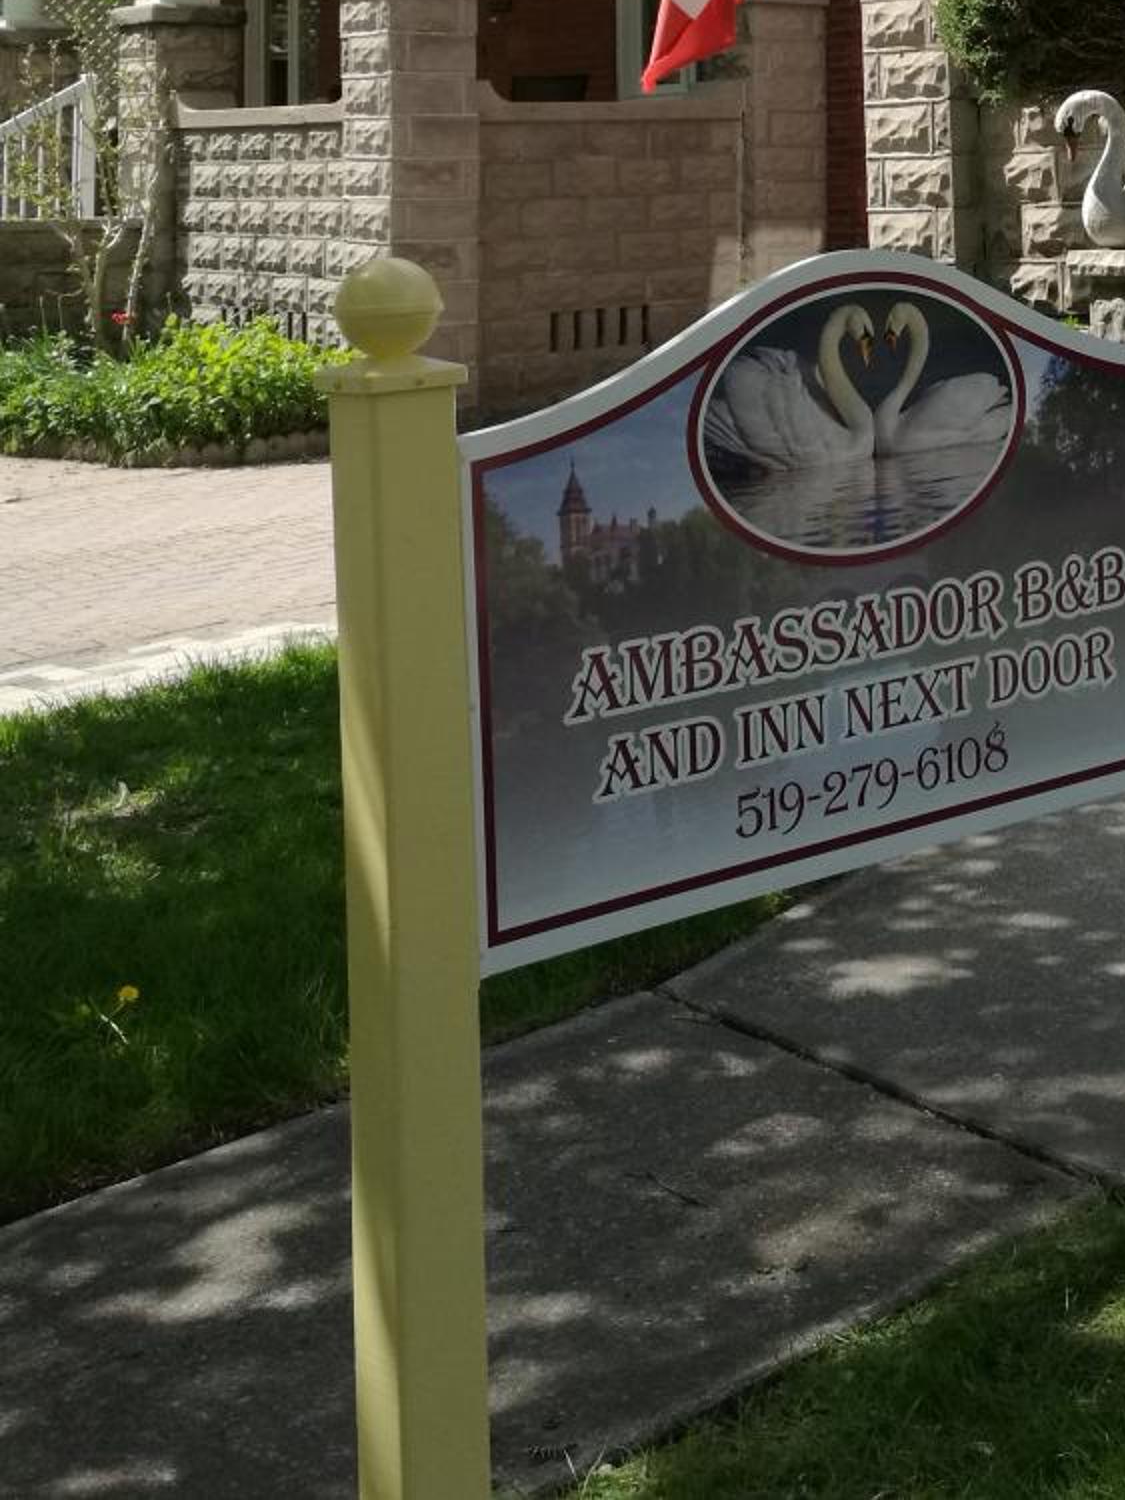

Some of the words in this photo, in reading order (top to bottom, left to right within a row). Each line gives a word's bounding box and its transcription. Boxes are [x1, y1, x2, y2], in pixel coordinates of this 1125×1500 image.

[569, 573, 1001, 719] AMBASSADOR
[598, 720, 721, 799] AND
[739, 695, 826, 765] INN
[844, 664, 975, 738] NEXT
[988, 631, 1116, 704] DOOR
[734, 722, 1010, 839] 519-279-6108
